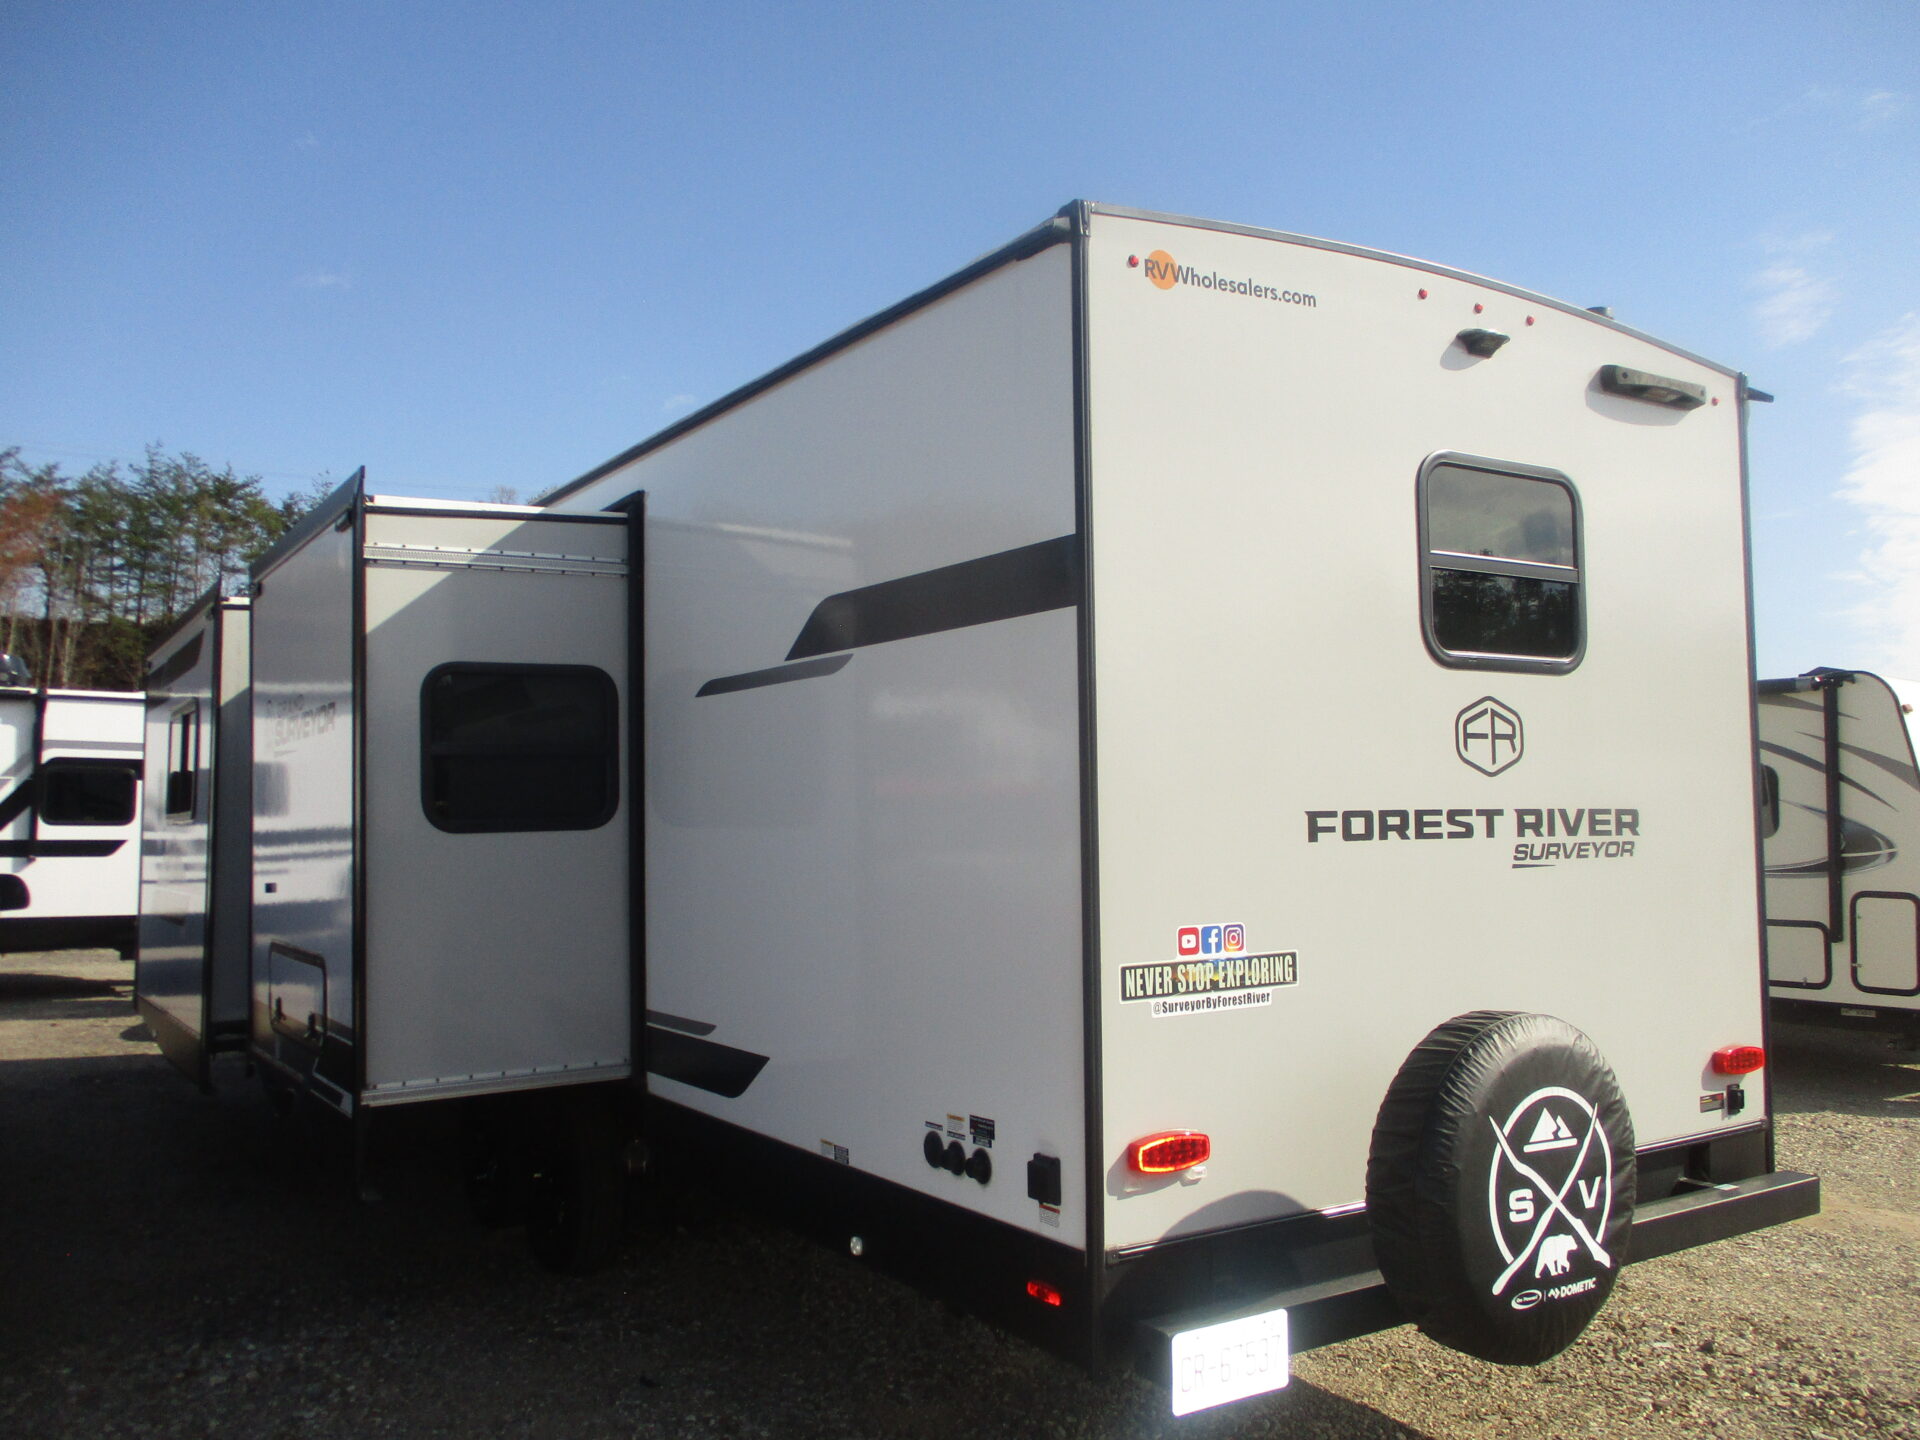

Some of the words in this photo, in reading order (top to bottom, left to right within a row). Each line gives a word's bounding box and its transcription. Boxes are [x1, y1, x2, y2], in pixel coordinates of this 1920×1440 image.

[1144, 258, 1317, 308] RVWholesalers.com
[1305, 808, 1504, 843] FOREST
[1513, 808, 1640, 838] RIVER
[1512, 841, 1636, 862] SURVEYOR
[1125, 965, 1173, 998] NEVER
[1177, 961, 1214, 994] STOP
[1218, 954, 1293, 989] EXPLORING
[1153, 992, 1270, 1015] @SurveyorByForestRiver
[1508, 1188, 1535, 1223] S
[1577, 1176, 1602, 1209] V
[1560, 1277, 1597, 1298] DOMETIC
